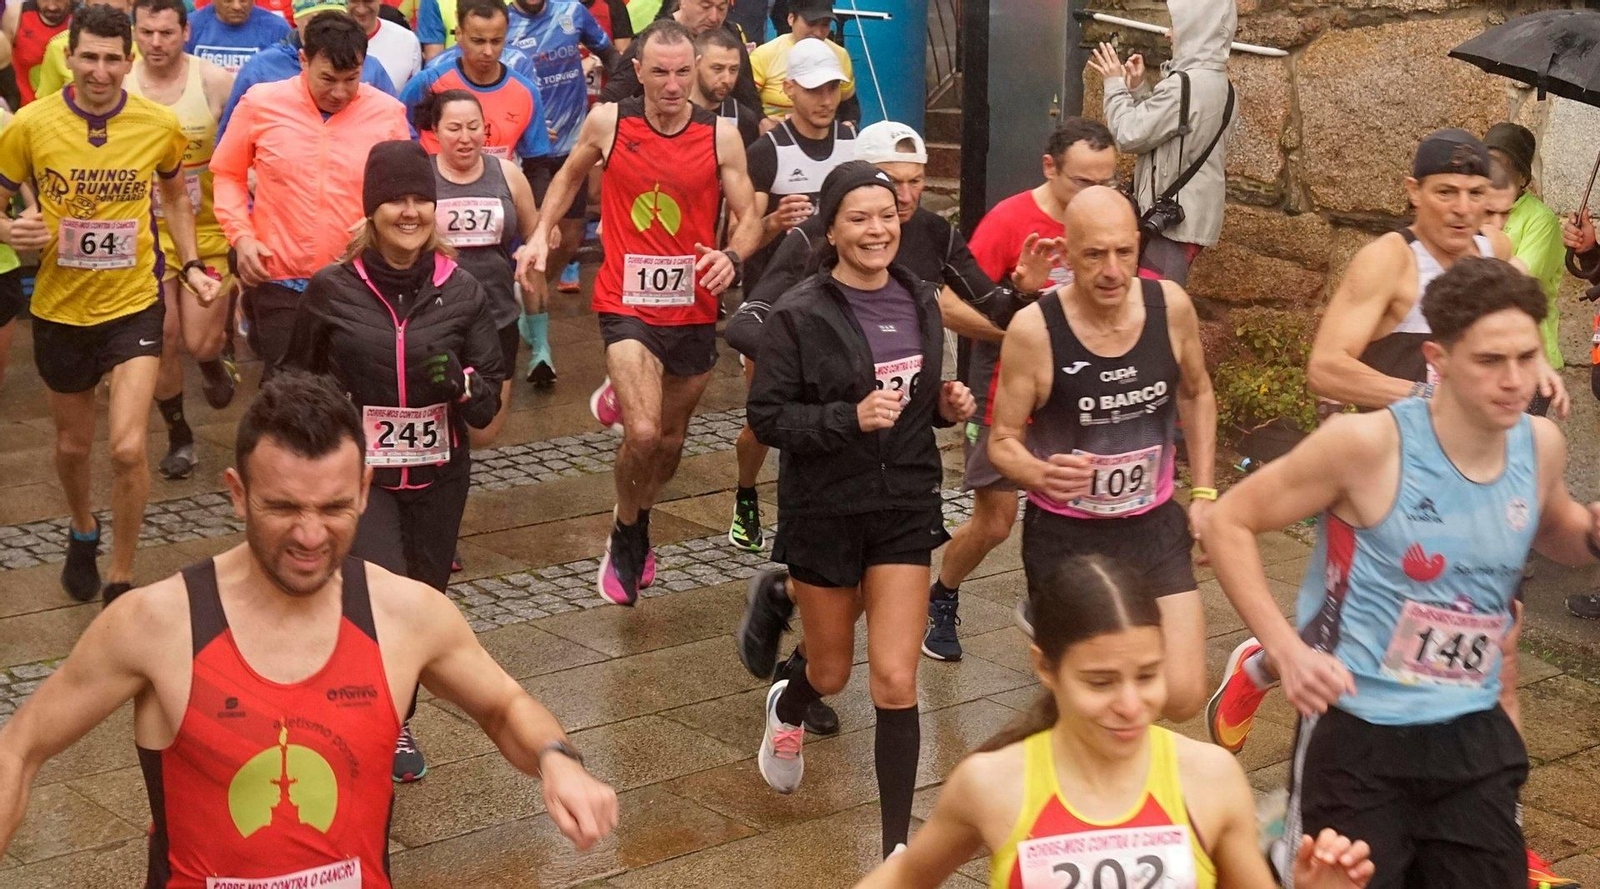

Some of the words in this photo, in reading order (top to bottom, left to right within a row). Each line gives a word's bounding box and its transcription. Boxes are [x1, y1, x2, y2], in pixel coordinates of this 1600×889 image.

[70, 169, 138, 182] TANINOS
[75, 180, 147, 195] RUNNERS
[448, 209, 492, 231] 237
[80, 232, 117, 255] 64
[637, 267, 684, 291] 107
[1078, 397, 1096, 411] O
[1100, 381, 1167, 410] BARCO
[378, 420, 438, 448] 245
[1091, 465, 1143, 497] 109
[271, 876, 308, 889] CONTRA
[319, 861, 356, 884] CANCRO
[1053, 855, 1164, 889] 202
